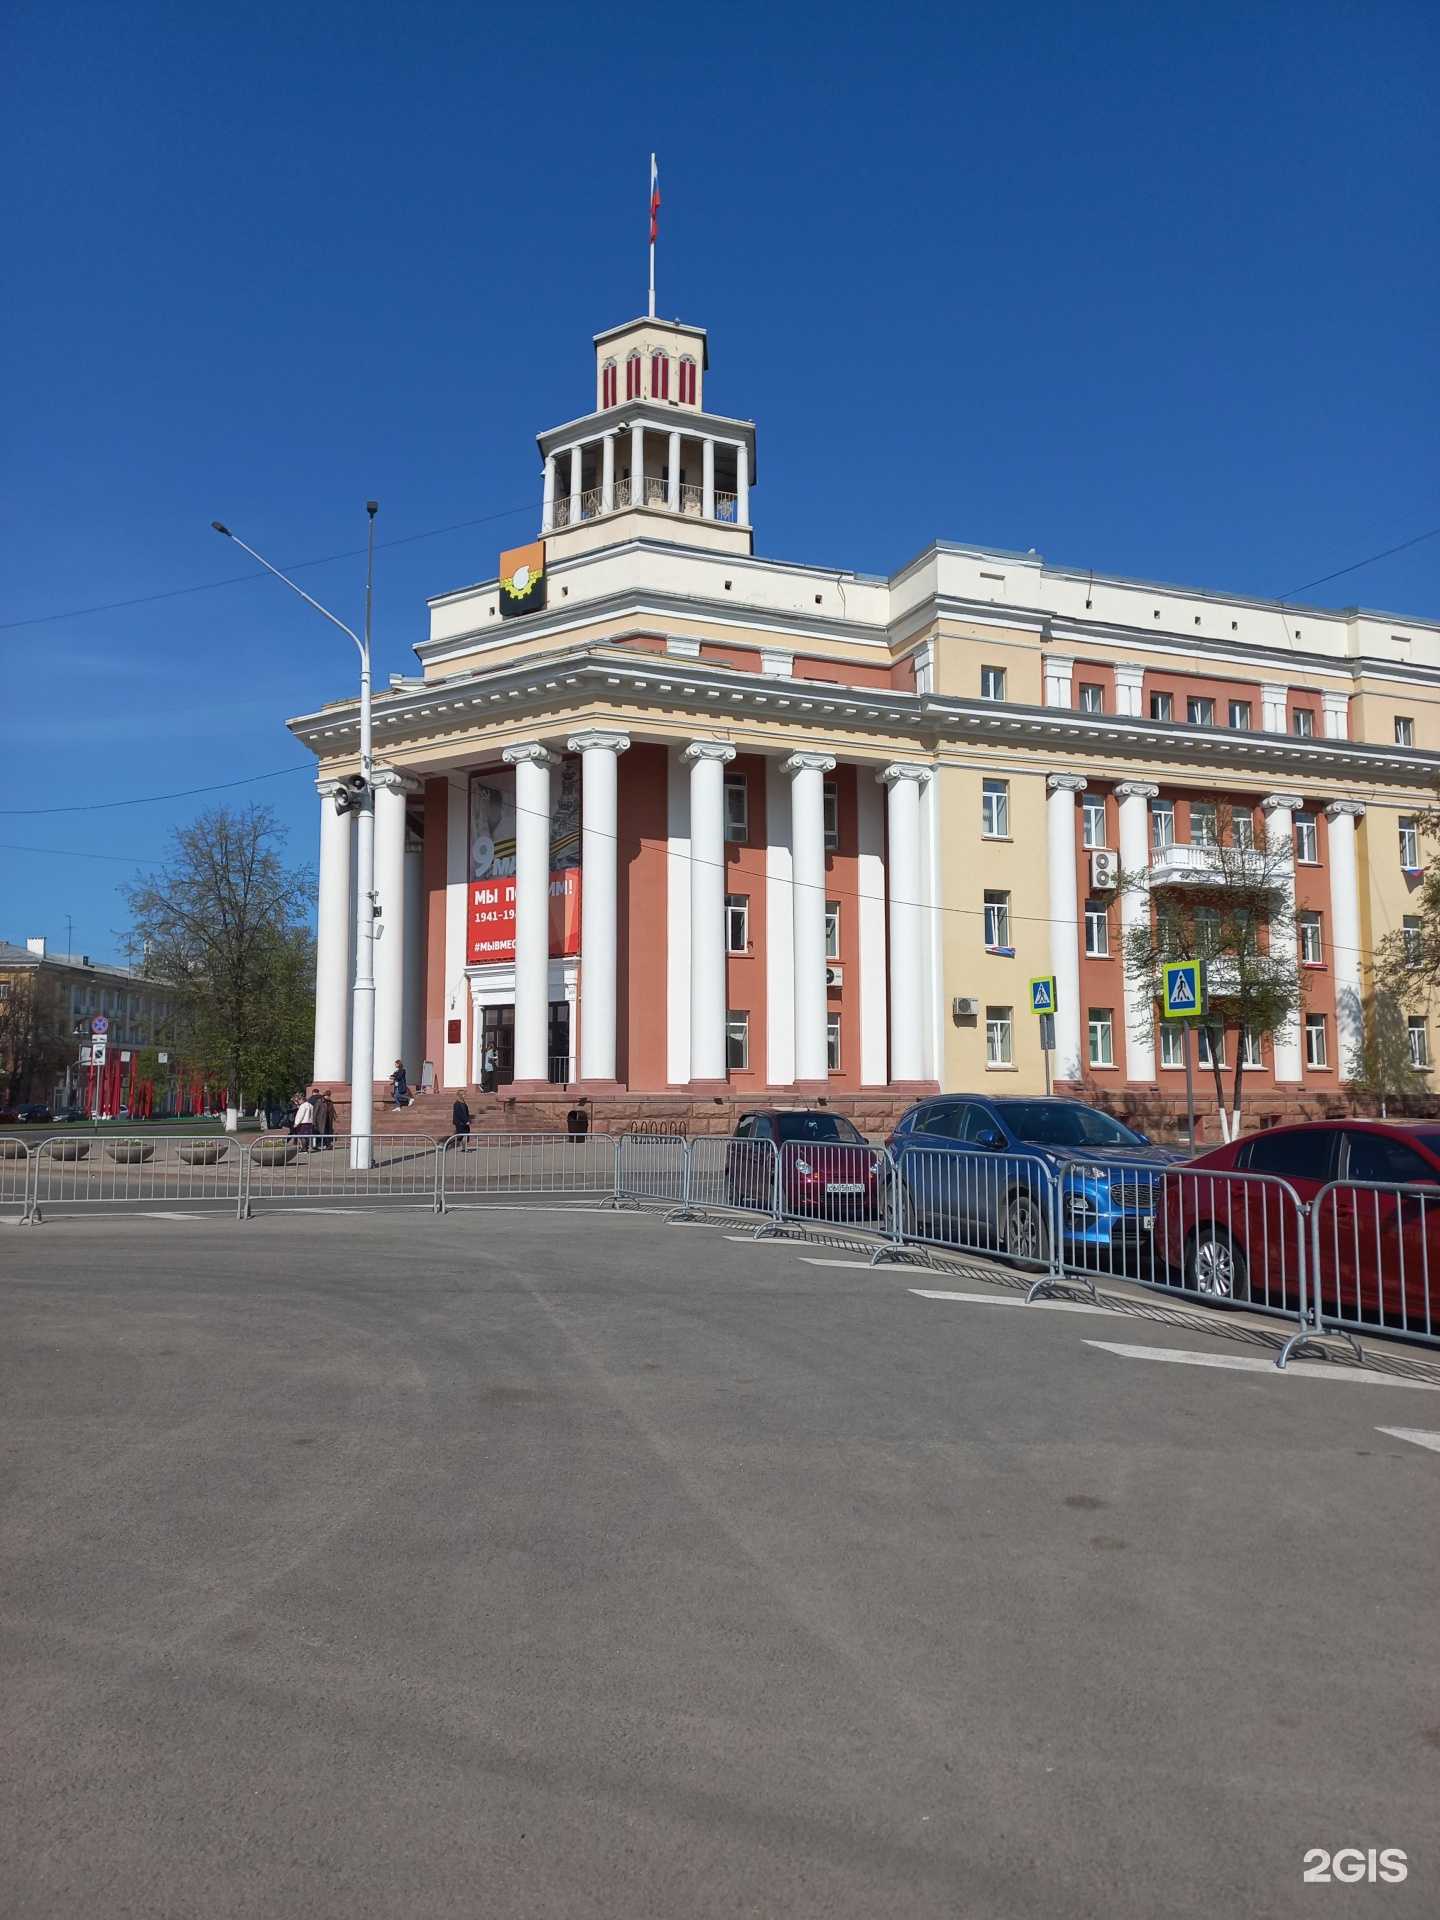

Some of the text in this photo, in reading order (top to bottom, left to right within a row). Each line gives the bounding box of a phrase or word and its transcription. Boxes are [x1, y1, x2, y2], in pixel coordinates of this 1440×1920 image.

[474, 887, 498, 906] МЫ
[474, 908, 517, 923] 1941-19
[474, 938, 517, 952] #МЫВМЕС
